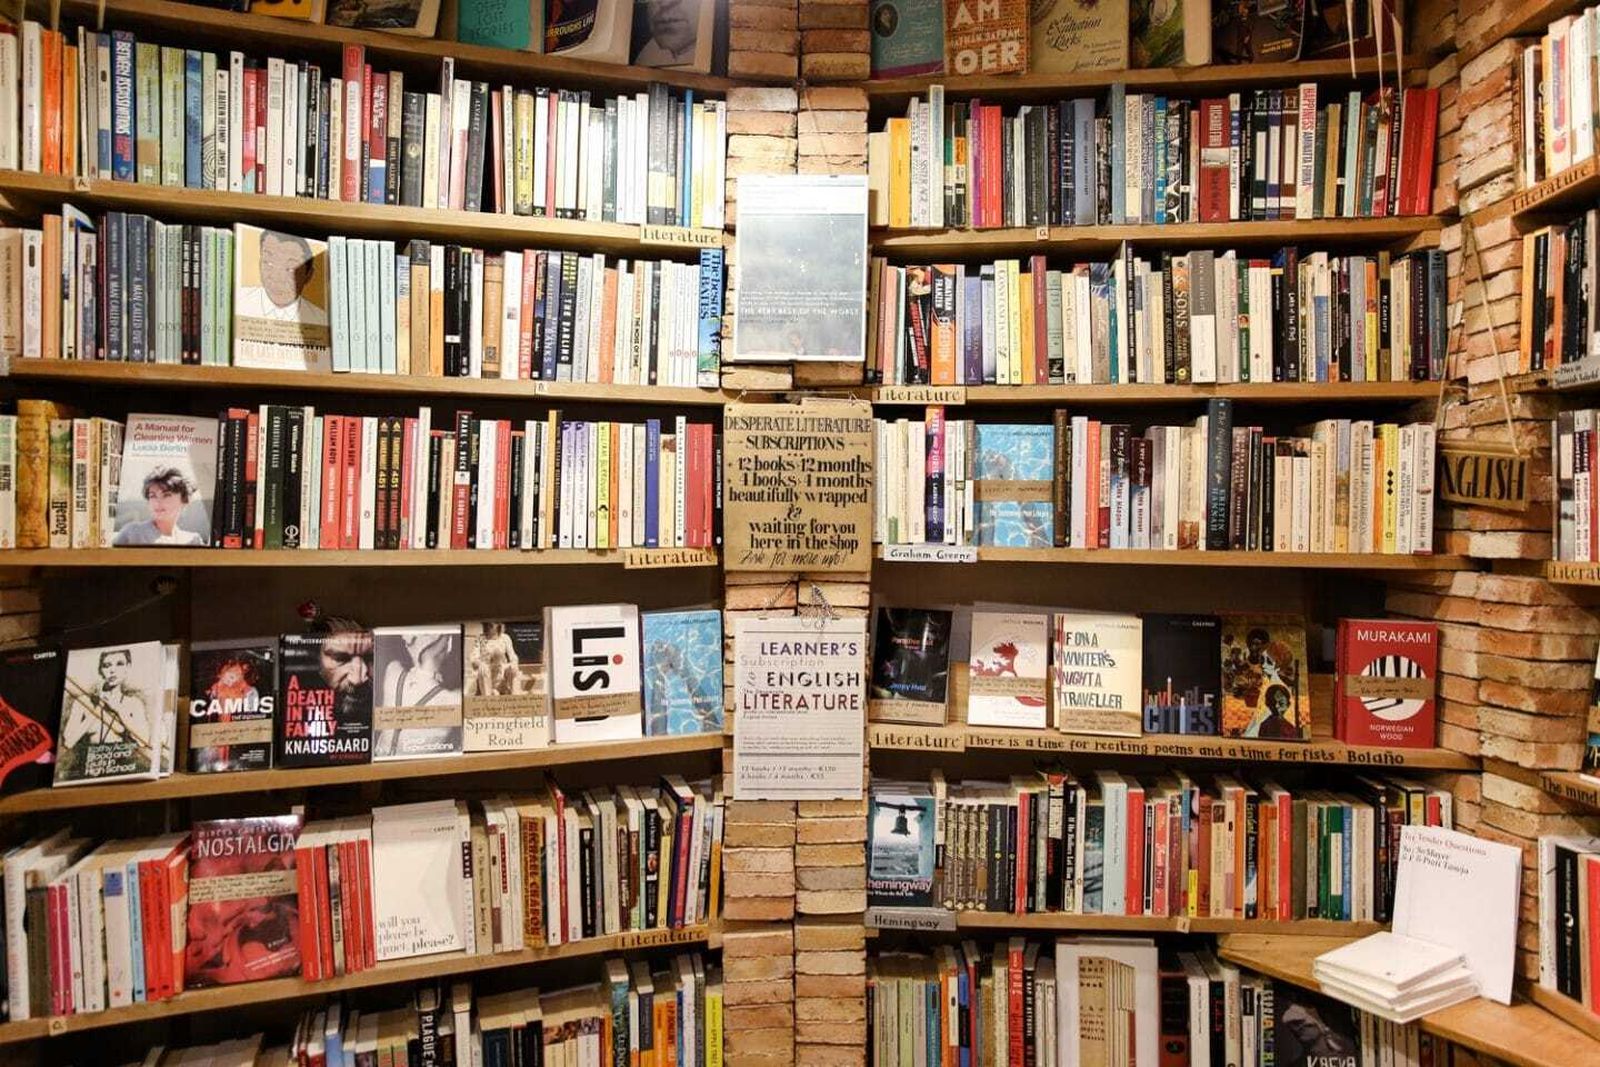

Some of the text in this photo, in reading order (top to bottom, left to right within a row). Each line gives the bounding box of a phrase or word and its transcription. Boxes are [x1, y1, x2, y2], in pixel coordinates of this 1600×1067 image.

[116, 41, 131, 134] BETWEEN ASSASSINATIONS
[1303, 88, 1315, 130] HAPPINESS
[1209, 105, 1222, 146] RICHARD FORD
[1303, 131, 1314, 164] AMINATTA
[1512, 169, 1588, 213] Literature
[644, 228, 717, 243] Literature
[110, 280, 119, 297] MAN
[711, 253, 720, 319] The best of
[935, 279, 943, 308] FRANZEN
[944, 277, 952, 310] JONATHAN
[110, 300, 119, 326] CALLED
[133, 284, 142, 344] MAN CALLED OVE
[1175, 290, 1187, 327] SONS
[561, 299, 571, 361] THE DARLING
[521, 331, 530, 368] BANKS
[544, 328, 552, 363] BANKS
[877, 389, 960, 402] Literature
[724, 416, 872, 433] DESPERATE LITERATURE
[1215, 411, 1226, 425] The
[145, 424, 180, 432] Manual
[182, 425, 195, 433] for
[348, 422, 356, 448] WILLIAM
[132, 443, 187, 452] Lucia Berlin
[134, 434, 213, 445] Cleaning Women
[329, 420, 337, 464] WILLIAM BOYD
[460, 415, 468, 470] PEARL BUCK
[746, 436, 845, 450] SUBSCRIPTIONS
[738, 455, 872, 473] 12 books 12 months
[931, 450, 940, 479] FURIES
[379, 471, 387, 488] 451
[391, 471, 400, 488] 451
[753, 472, 872, 488] books months
[457, 488, 466, 499] THE
[729, 487, 868, 508] beautifully wrapped
[52, 501, 68, 535] Herzog
[1210, 488, 1218, 531] HANNAH
[749, 518, 856, 538] waiting for you
[750, 534, 859, 554] here in the shop
[630, 550, 712, 566] Literature
[770, 551, 818, 568] for more
[890, 549, 970, 560] Graham Greene
[1074, 631, 1099, 648] ON A
[1357, 630, 1431, 643] MURAKAMI
[761, 642, 857, 656] LEARNER'S
[741, 655, 825, 670] Subscription
[1063, 649, 1116, 667] WINTER'S
[288, 675, 299, 689] A
[767, 672, 860, 687] ENGLISH
[1062, 671, 1102, 687] NIGHT A
[190, 696, 274, 717] CAMUS
[288, 690, 335, 706] DEATH
[743, 694, 859, 710] LITERATURE
[1061, 692, 1122, 709] TRAVELLER
[287, 706, 334, 720] IN THE
[1144, 697, 1214, 734] CITIES
[286, 721, 337, 737] FAMILY
[466, 717, 544, 732] Springfield
[1369, 724, 1414, 733] NORWEGIAN
[488, 734, 523, 746] Road
[876, 733, 960, 749] Literature
[1380, 733, 1403, 741] WOOD
[285, 738, 369, 754] KNAUSGAARD
[970, 735, 1005, 746] There
[1009, 738, 1019, 747] is
[1026, 739, 1034, 747] a
[1038, 737, 1064, 749] time
[1070, 739, 1088, 750] for
[1095, 741, 1148, 755] reciting
[1155, 744, 1194, 755] poems
[1199, 745, 1223, 756] and
[1229, 747, 1237, 757] a
[1240, 746, 1272, 759] time
[1278, 747, 1298, 760] for
[1347, 749, 1404, 764] Bolaño
[87, 751, 132, 760] Blood and
[85, 764, 136, 776] High School
[198, 833, 297, 857] NOSTALGIA
[463, 842, 471, 878] CARVER
[529, 821, 540, 936] MICHAEL CHABON
[868, 879, 931, 894] hemingway
[379, 916, 422, 928] will you
[875, 915, 939, 929] Hemingway
[412, 934, 454, 953] please?
[622, 931, 705, 947] Literature
[422, 1015, 434, 1058] PLAGUE
